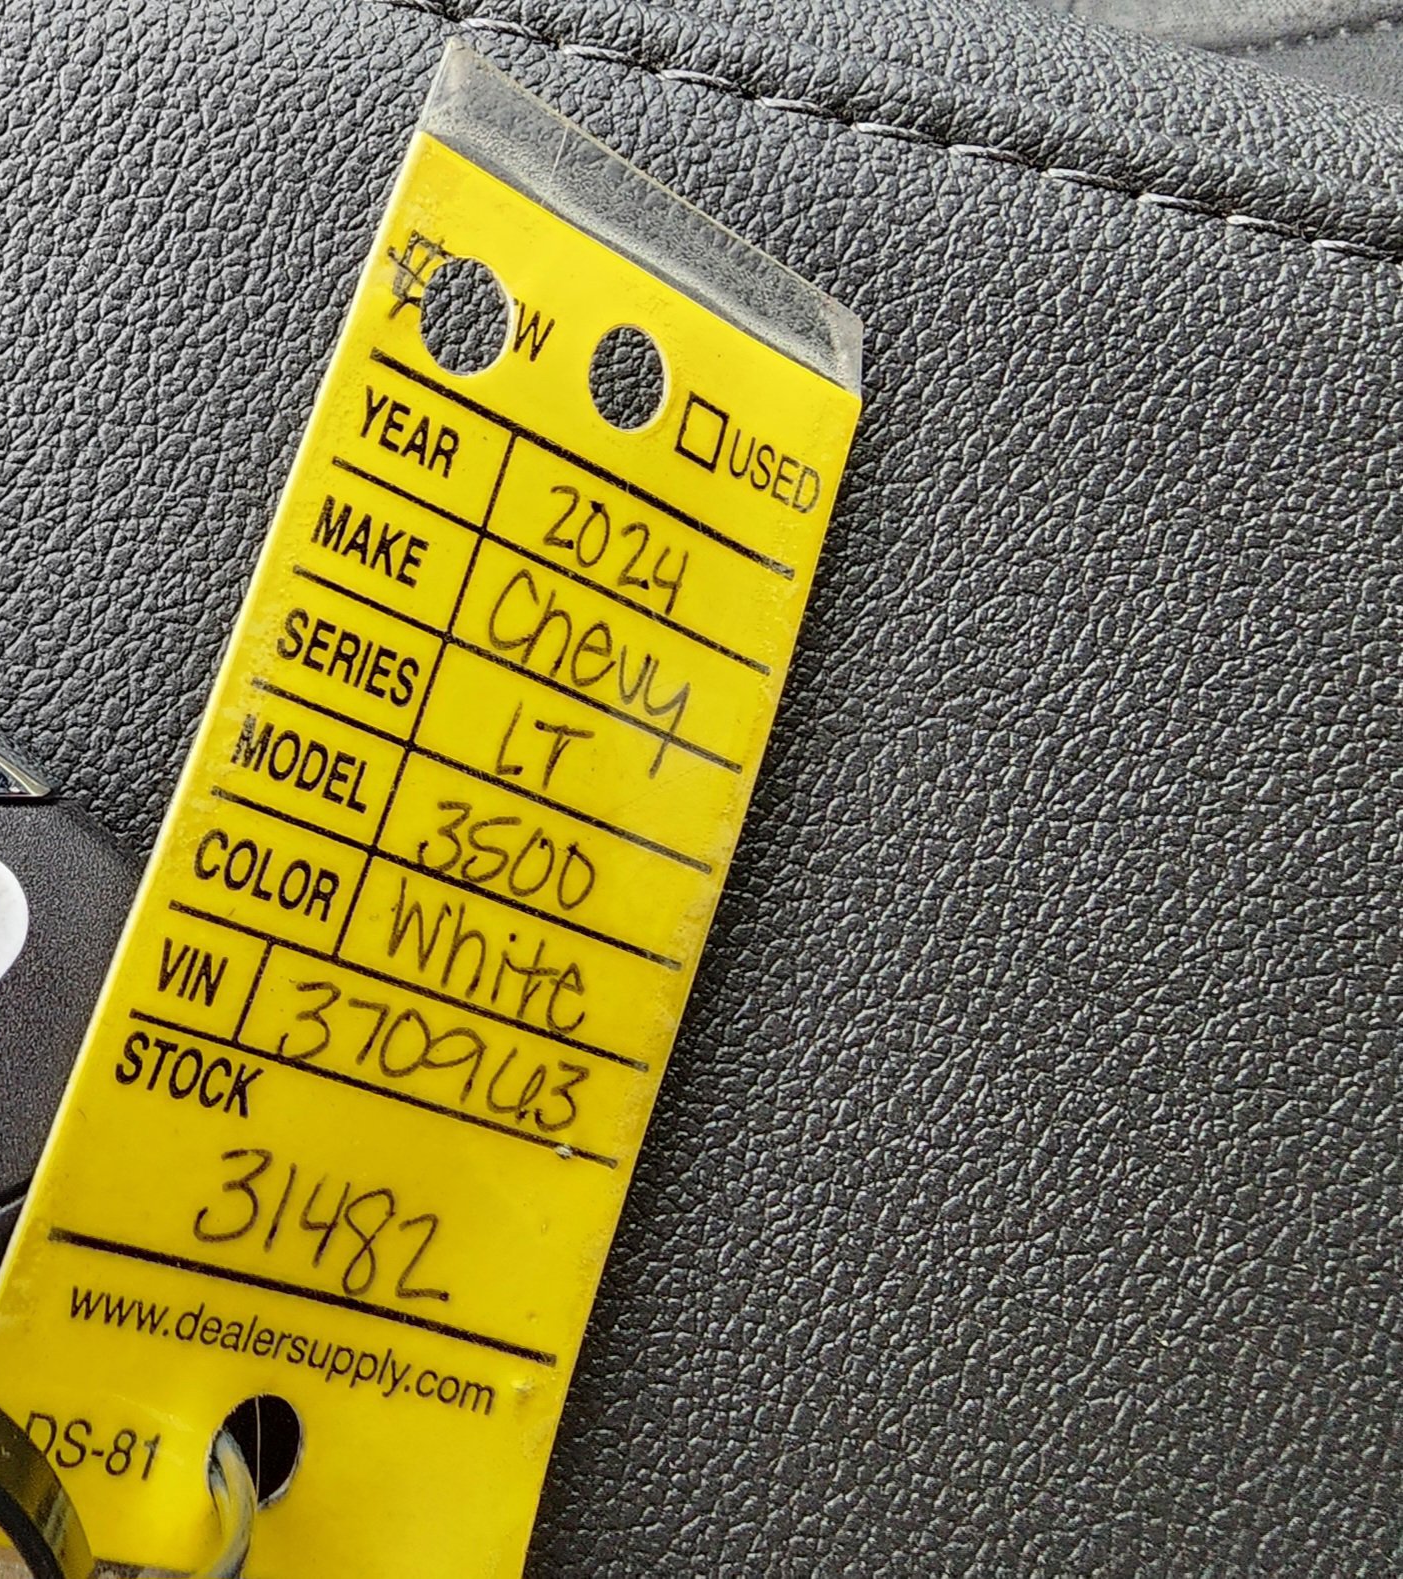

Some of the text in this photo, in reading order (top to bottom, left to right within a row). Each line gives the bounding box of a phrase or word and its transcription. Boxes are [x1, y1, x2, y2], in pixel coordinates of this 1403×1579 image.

[359, 386, 460, 478] YEAR
[727, 427, 821, 514] USED
[311, 495, 429, 589] MAKE
[542, 485, 689, 615] 2024
[275, 607, 420, 708] SERIES
[488, 568, 692, 779] Chevy
[230, 714, 368, 814] MODEL
[495, 701, 594, 790] LT
[194, 828, 340, 922] COLOR
[416, 800, 596, 910] 3500
[157, 937, 229, 1007] VIN
[386, 876, 586, 1036] White
[115, 1031, 264, 1118] STOCK
[277, 980, 591, 1133] 370963
[193, 1149, 450, 1302] 31482
[69, 1285, 497, 1417] www.dealersupply.com
[25, 1410, 161, 1481] DS-81
